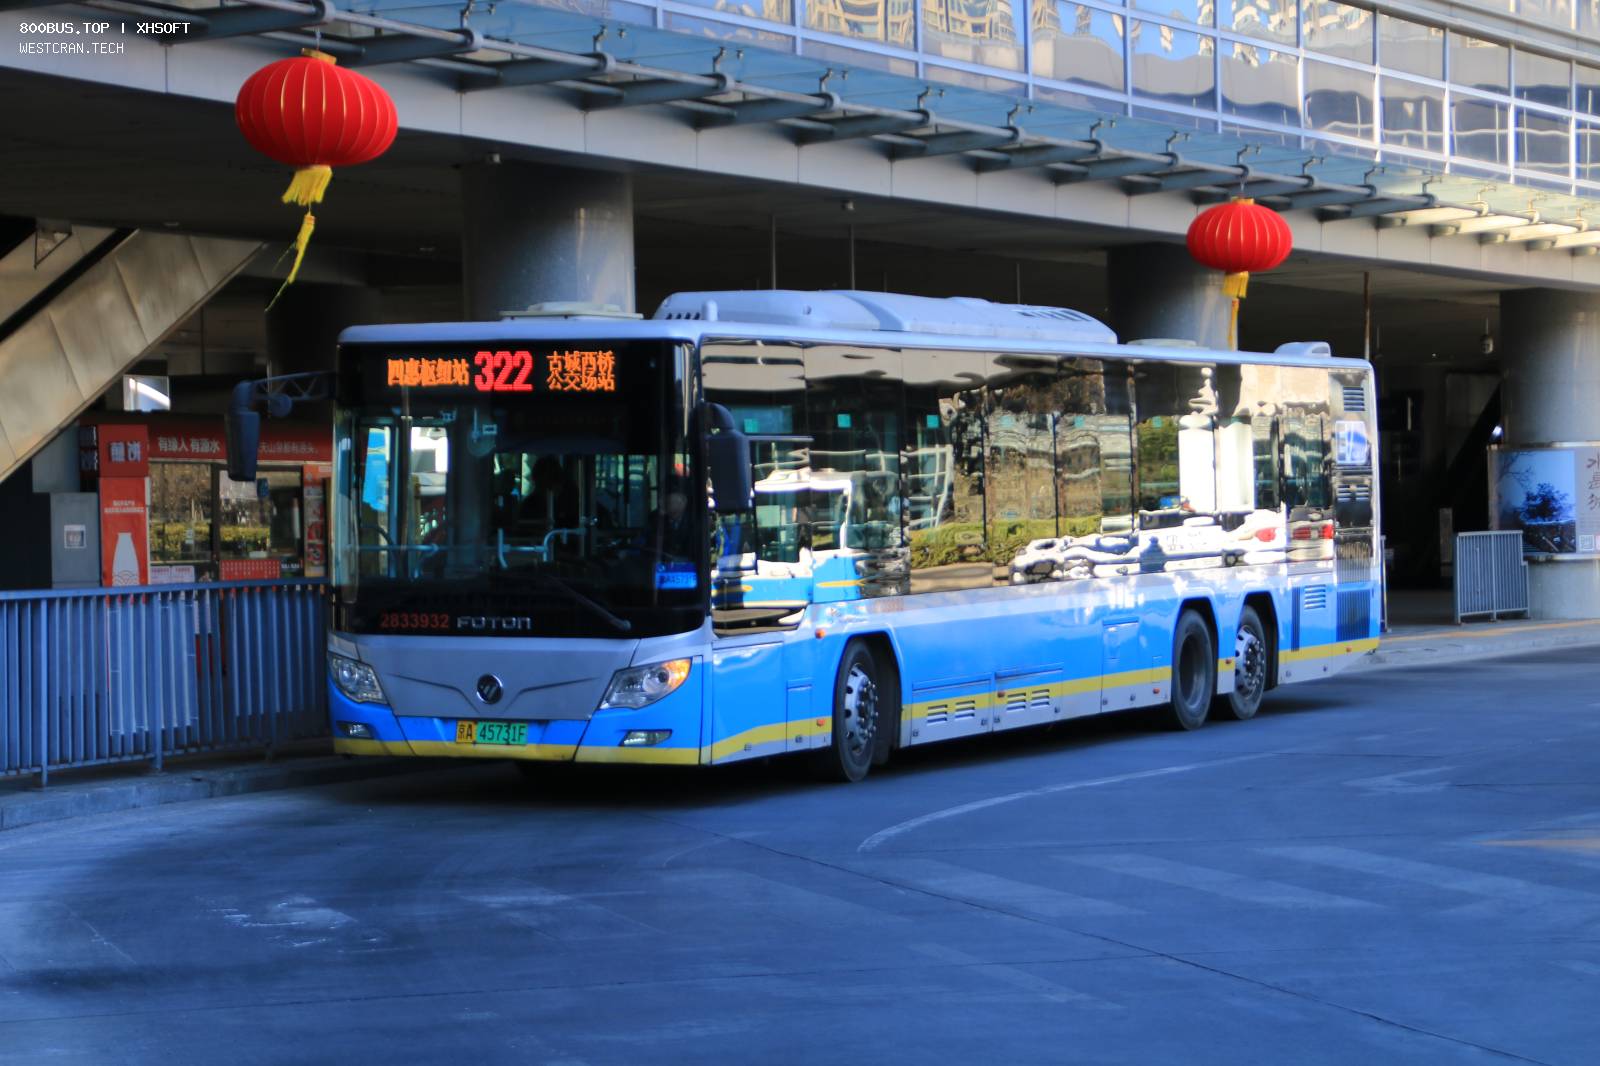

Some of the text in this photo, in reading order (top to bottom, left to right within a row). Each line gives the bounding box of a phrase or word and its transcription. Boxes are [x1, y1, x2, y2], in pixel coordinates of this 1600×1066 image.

[474, 350, 534, 392] 322
[546, 370, 616, 392] 公交场站
[380, 612, 532, 630] 2833932 FOTON
